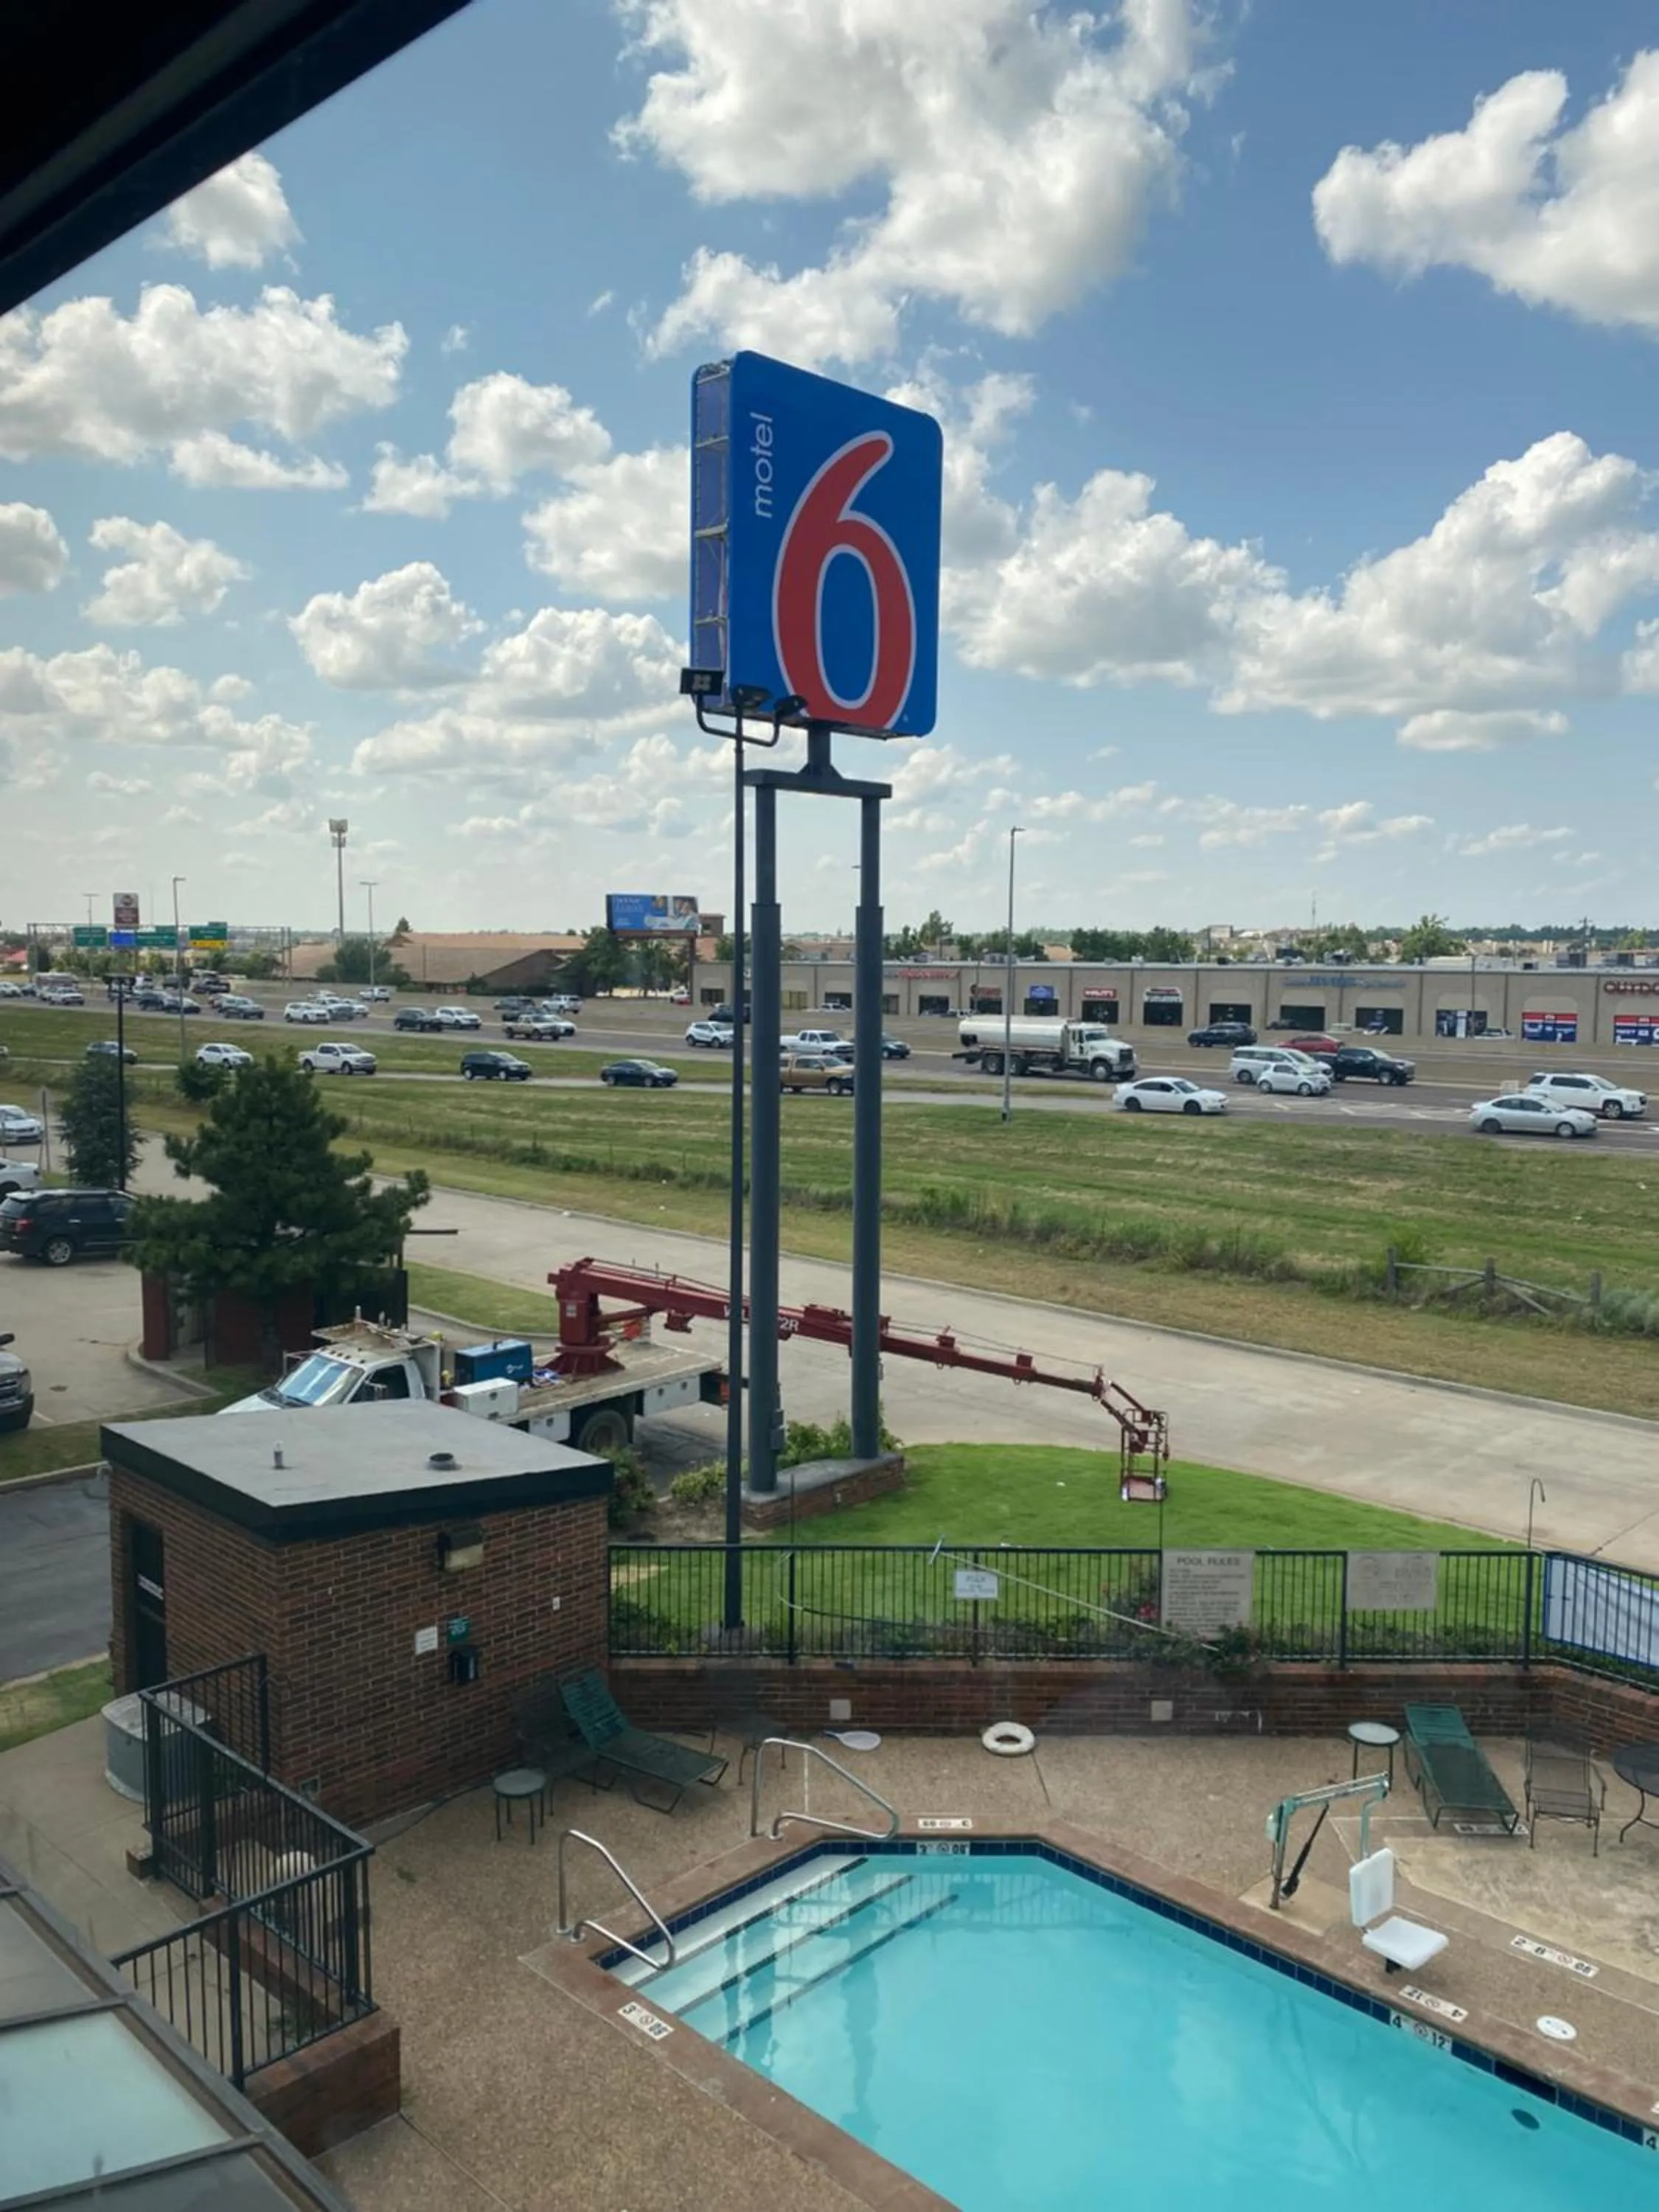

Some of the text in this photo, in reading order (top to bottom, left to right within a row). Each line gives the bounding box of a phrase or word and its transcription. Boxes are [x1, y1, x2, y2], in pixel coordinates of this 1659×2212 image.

[749, 412, 773, 518] motel
[772, 429, 917, 730] 6
[1177, 1556, 1240, 1566] POOL RULES
